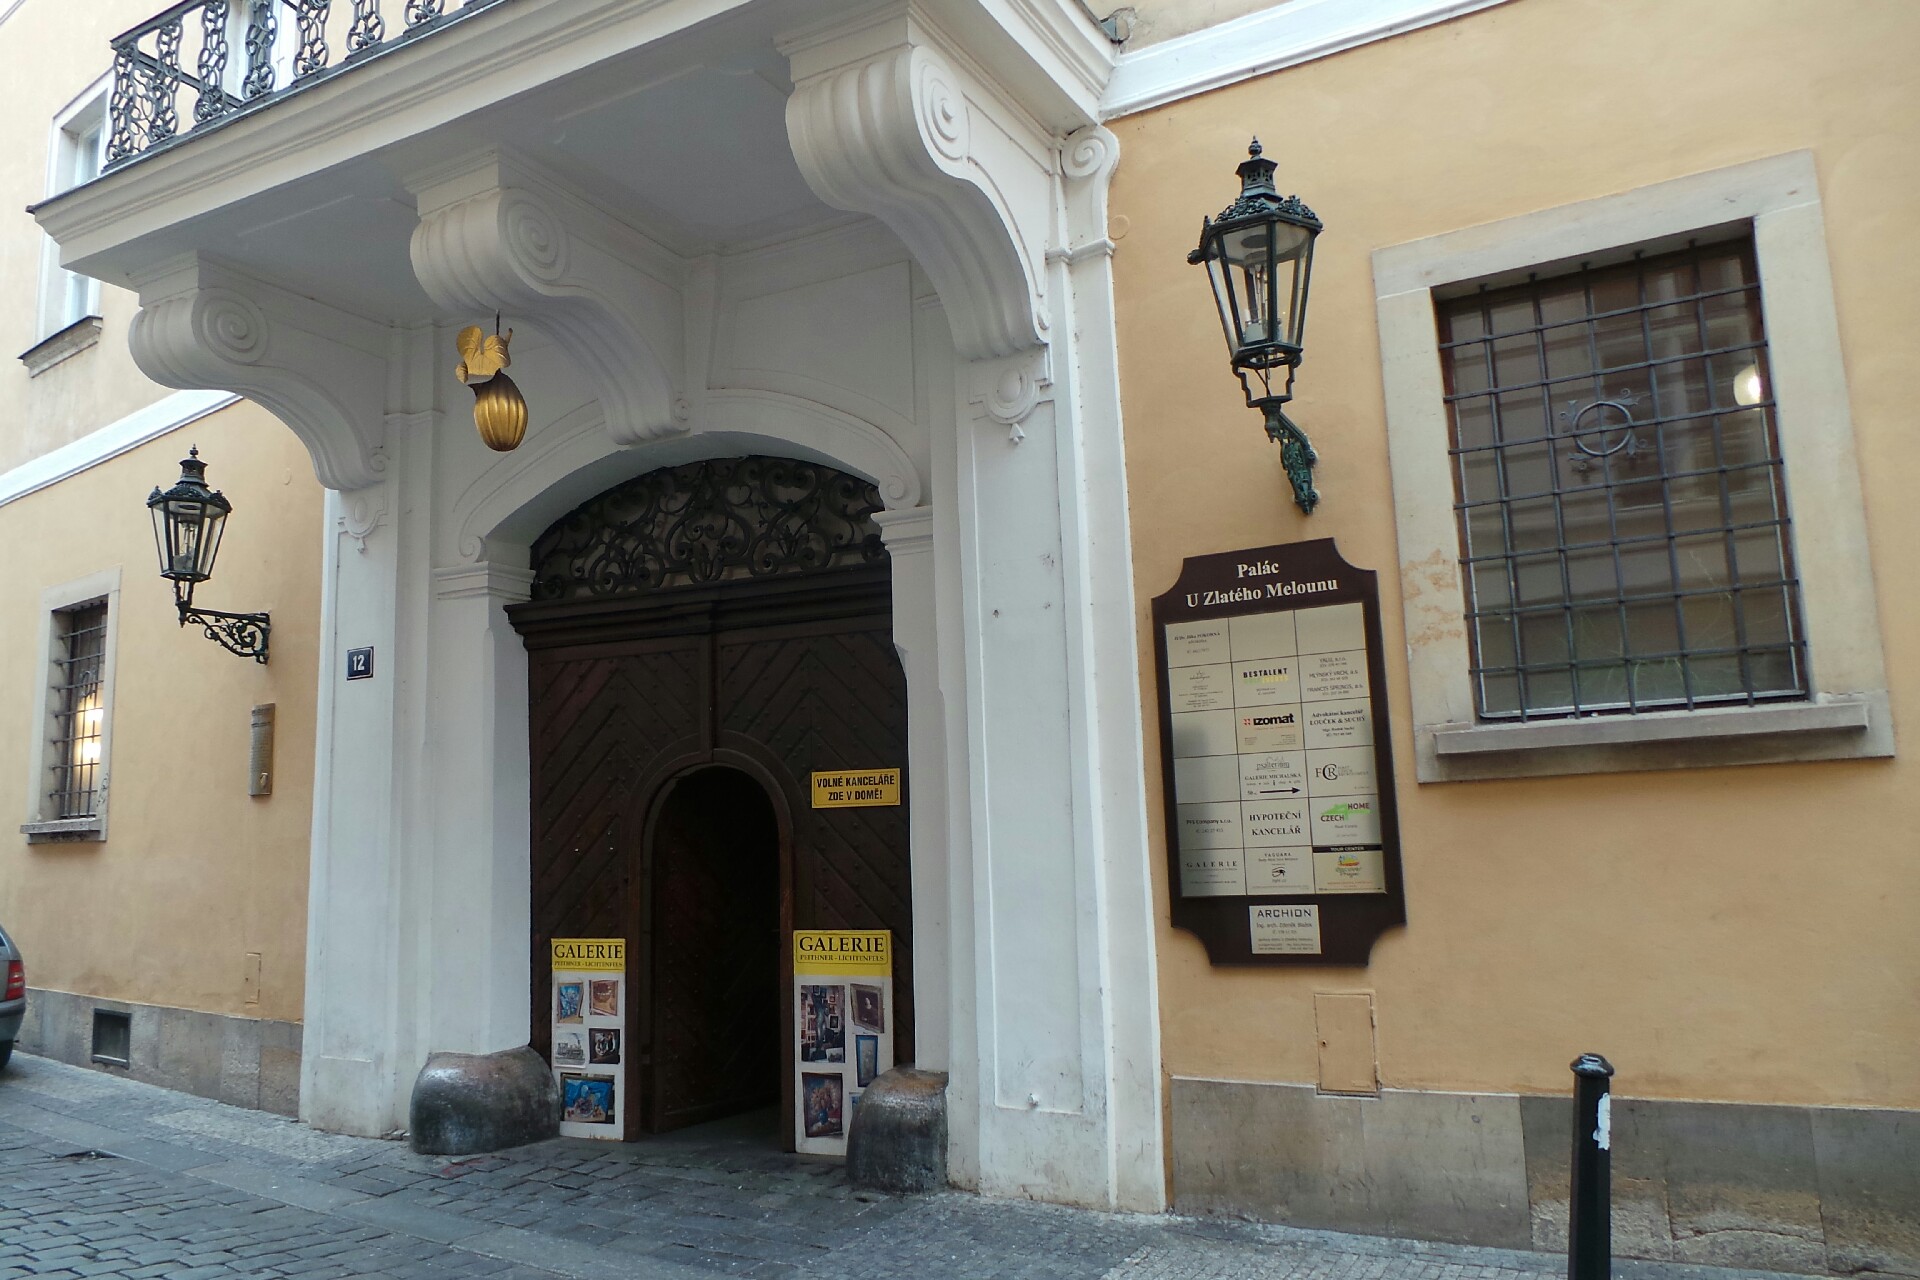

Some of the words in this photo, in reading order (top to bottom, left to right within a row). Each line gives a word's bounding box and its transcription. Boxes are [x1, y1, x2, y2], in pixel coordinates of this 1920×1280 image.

[1237, 560, 1279, 578] Palác
[1186, 593, 1199, 608] U
[1203, 587, 1262, 606] Zlatého
[1265, 579, 1338, 598] Melounu
[352, 654, 364, 670] 12
[1243, 668, 1288, 678] BESTALENT
[1253, 713, 1294, 726] izomat
[816, 776, 843, 788] VOLNÉ
[845, 773, 895, 787] KANCELÁŘE
[828, 791, 843, 800] ZDE
[846, 791, 852, 800] V
[855, 788, 883, 800] DOMĚ!
[1347, 802, 1369, 810] HOME
[1249, 810, 1302, 821] HYPOTEČNÍ
[1320, 814, 1344, 822] CZECH
[1251, 825, 1301, 836] KANCELÁŘ
[1257, 909, 1312, 918] ARCHION
[800, 936, 884, 952] GALERIE
[554, 944, 623, 958] GALERIE
